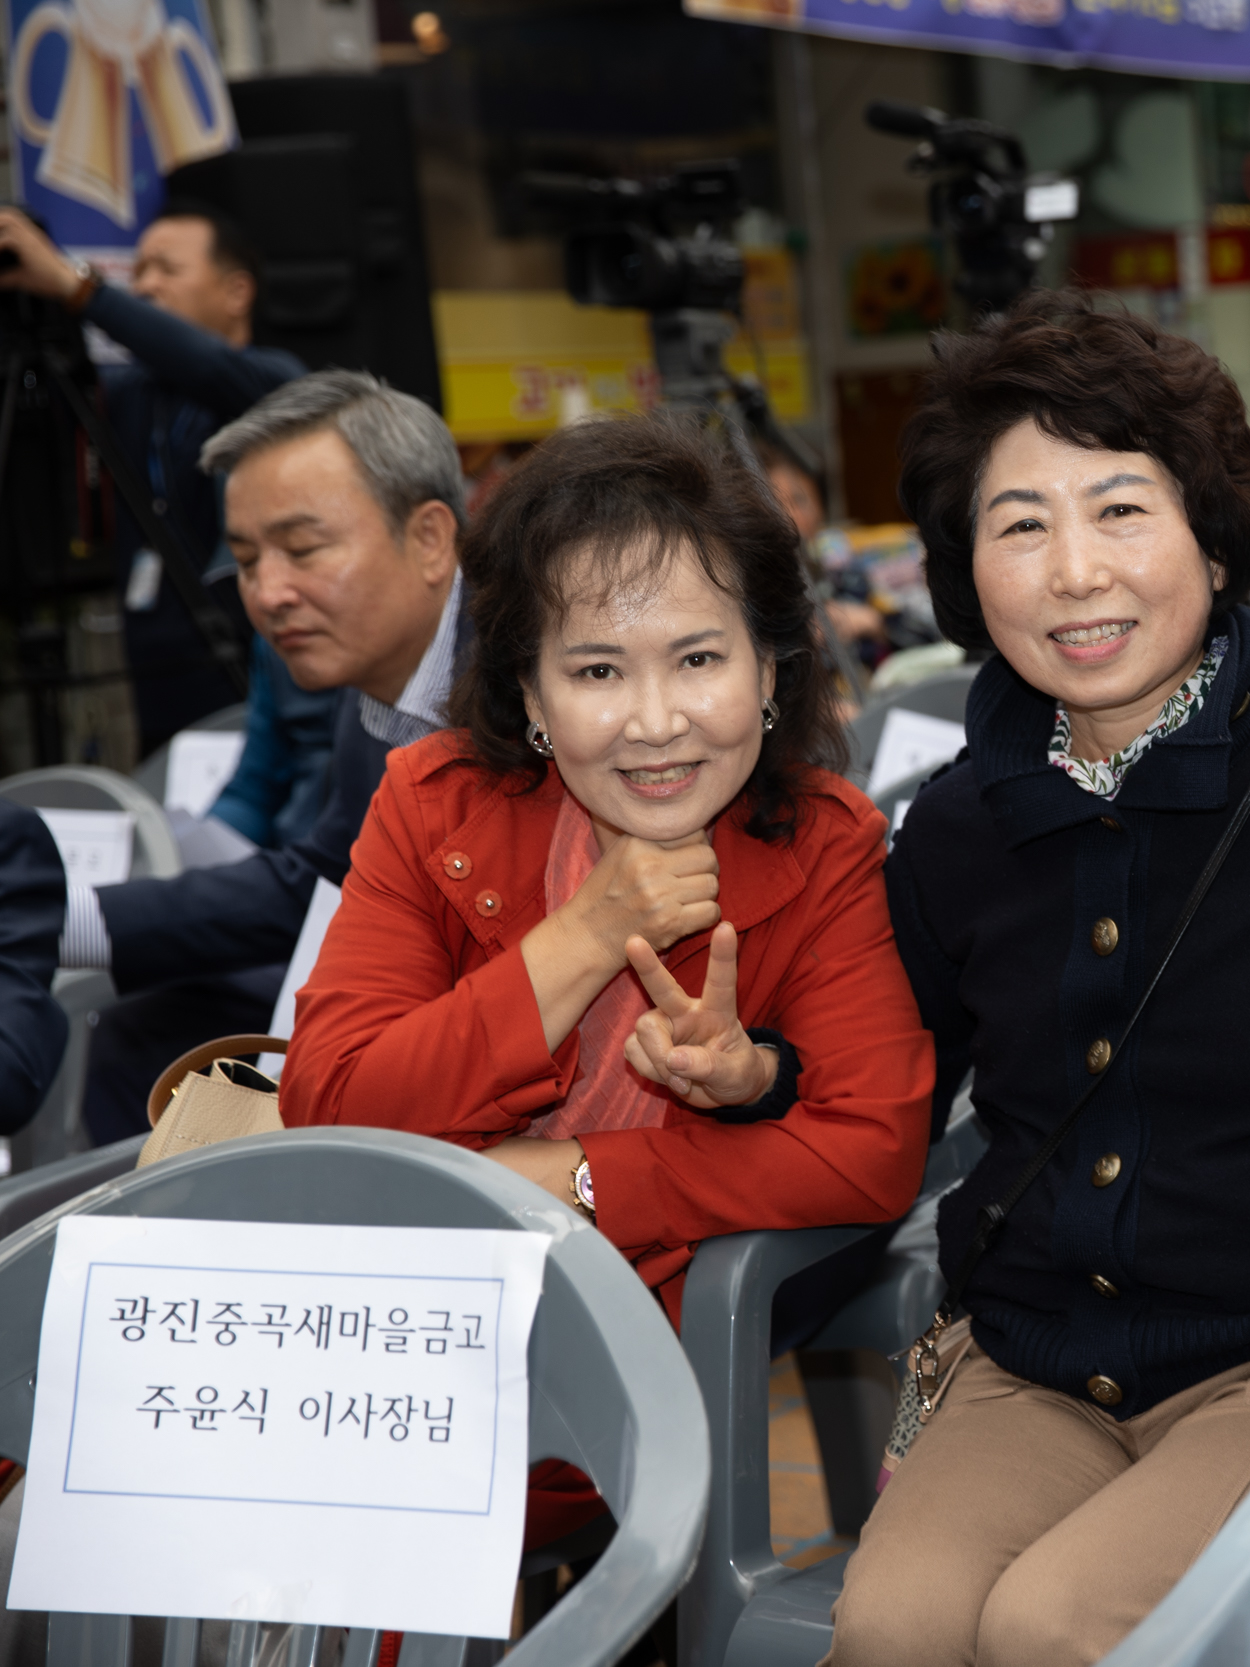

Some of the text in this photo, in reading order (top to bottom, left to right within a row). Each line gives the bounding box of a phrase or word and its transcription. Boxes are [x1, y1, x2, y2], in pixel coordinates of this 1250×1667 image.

[109, 1295, 486, 1356] 광진중곡새마을금고
[135, 1385, 455, 1443] 주윤식 이사장님
